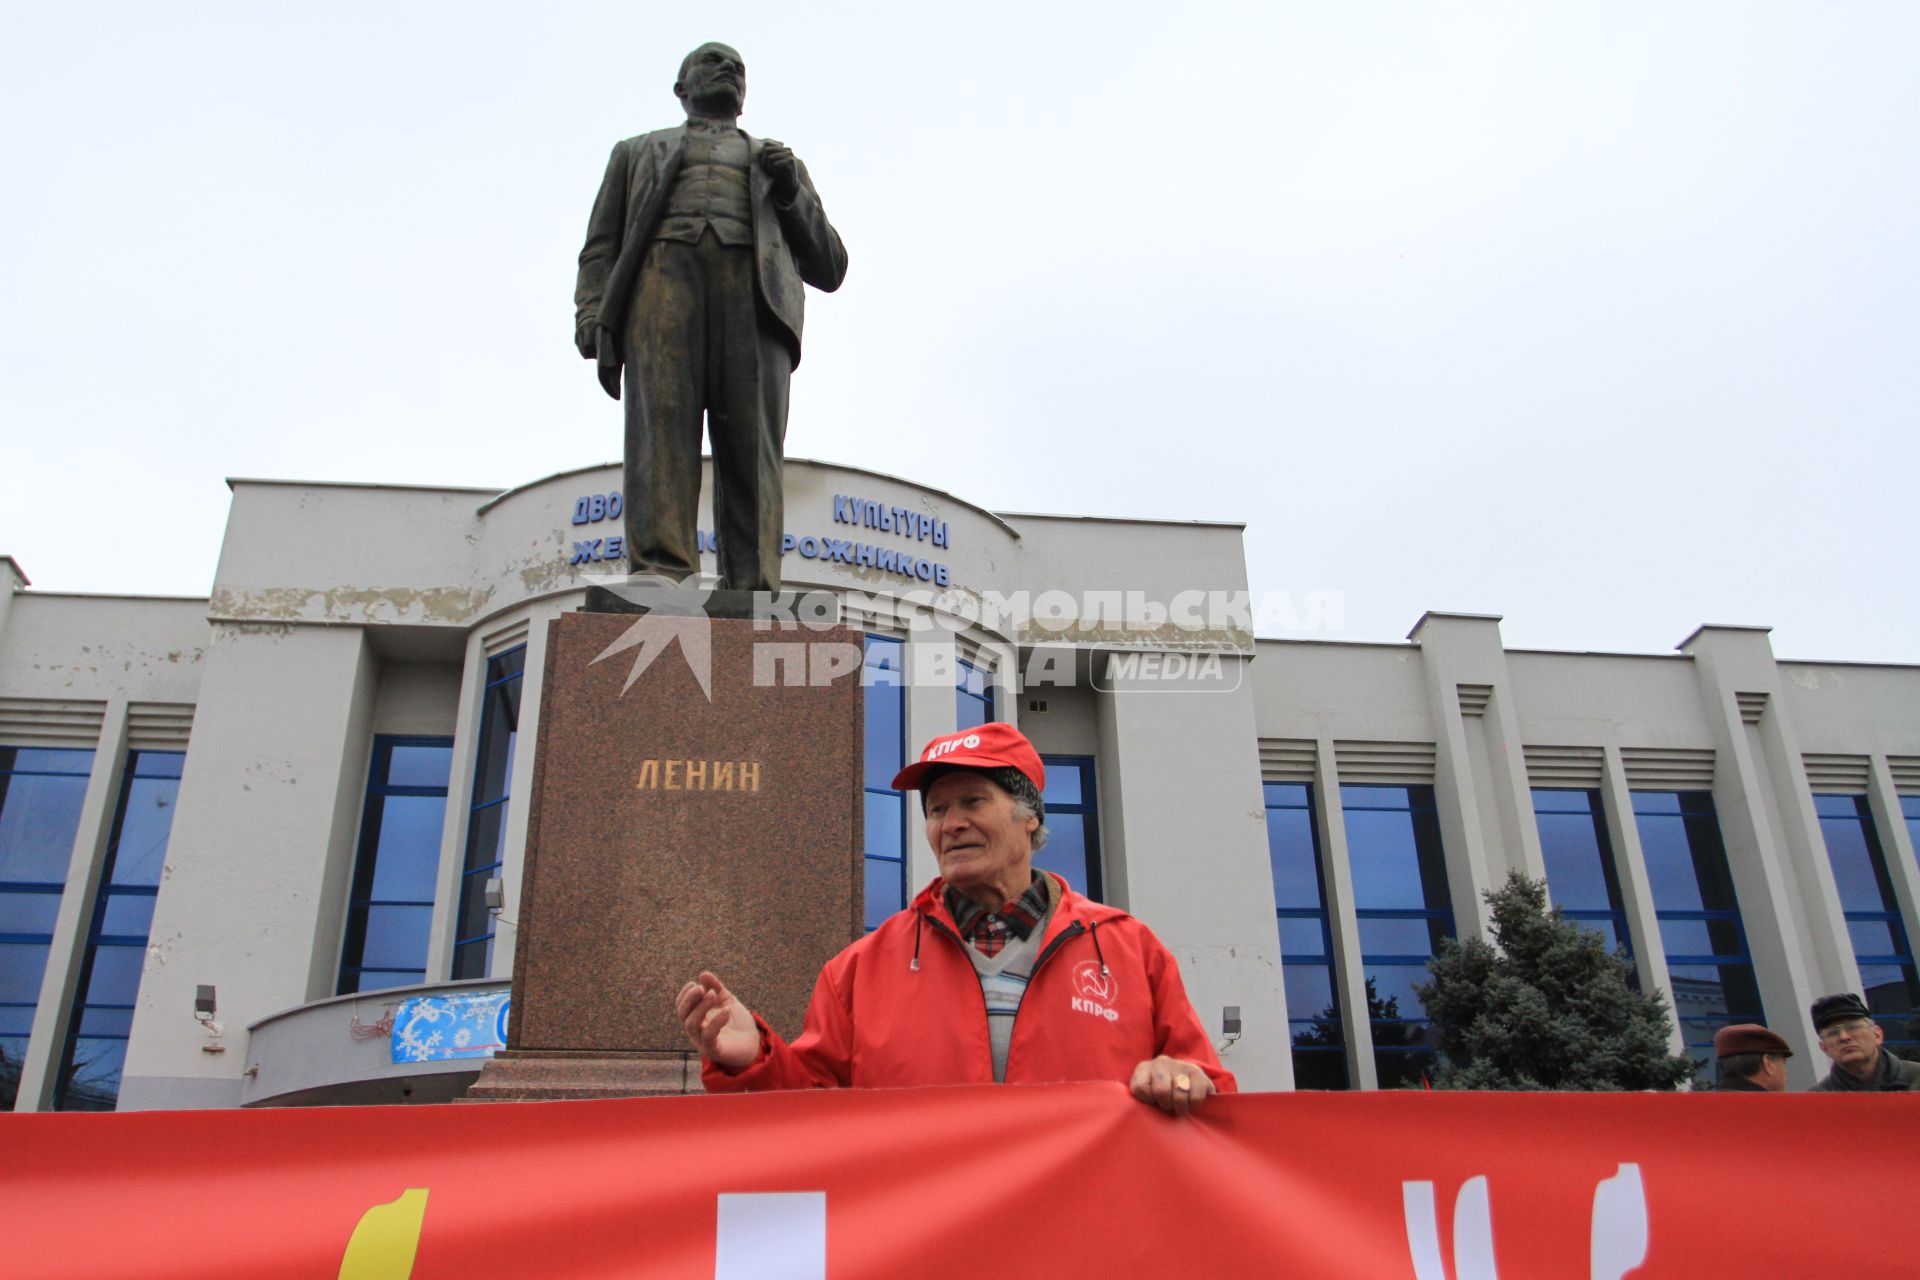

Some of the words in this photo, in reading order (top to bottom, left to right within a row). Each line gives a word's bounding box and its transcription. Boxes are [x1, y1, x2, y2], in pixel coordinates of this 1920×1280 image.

[572, 491, 623, 525] ДВО
[833, 494, 949, 549] КУЛЬТУРЫ
[927, 734, 981, 761] КПРФ
[636, 758, 761, 791] ЛЕНИН
[1071, 996, 1119, 1022] КПРФ
